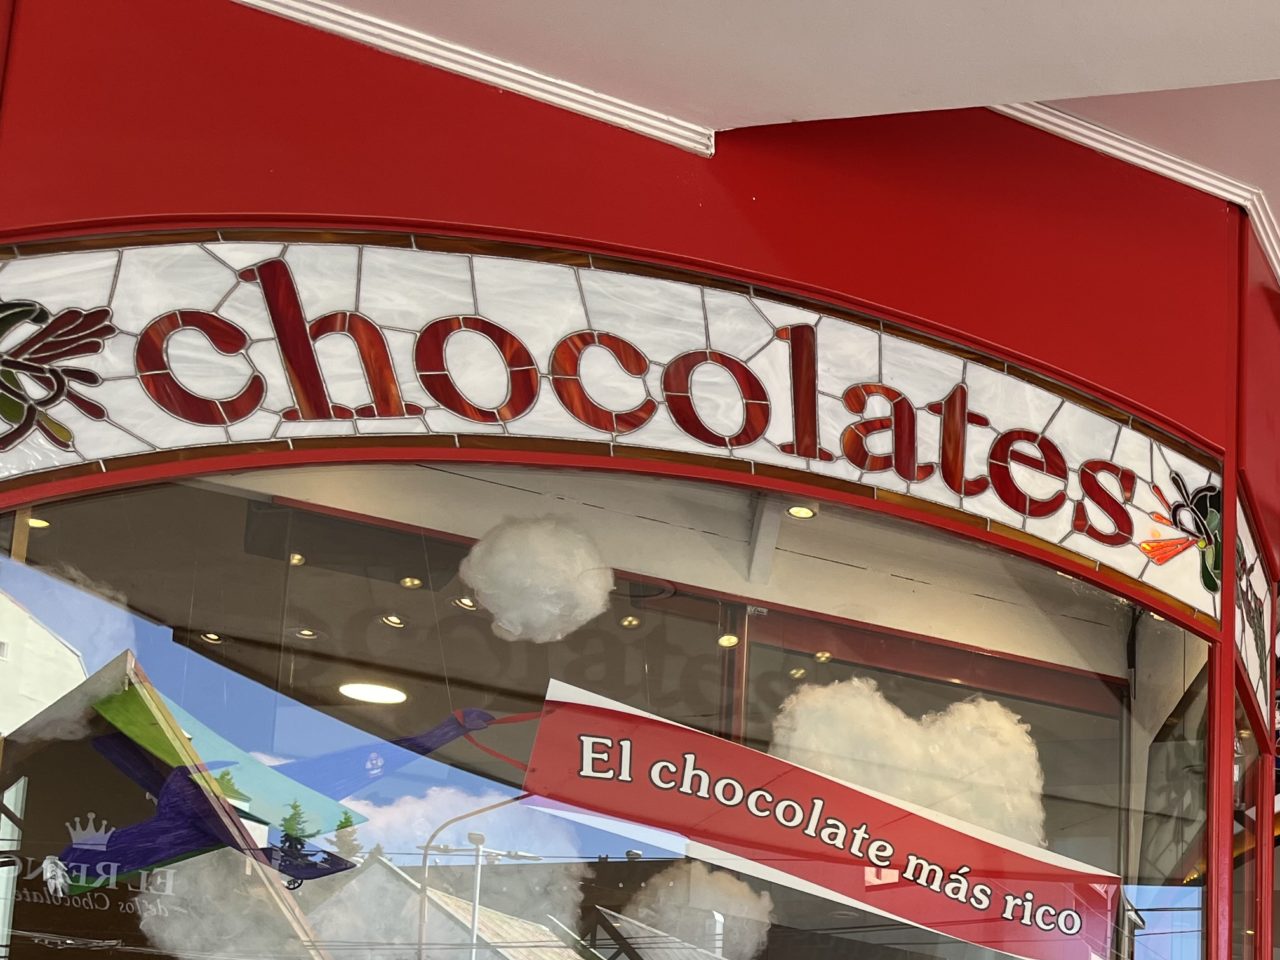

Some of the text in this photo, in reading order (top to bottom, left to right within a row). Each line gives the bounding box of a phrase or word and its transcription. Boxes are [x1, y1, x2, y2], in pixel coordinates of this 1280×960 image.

[134, 258, 1136, 547] chocolates
[578, 735, 1083, 936] El chocolate más rico
